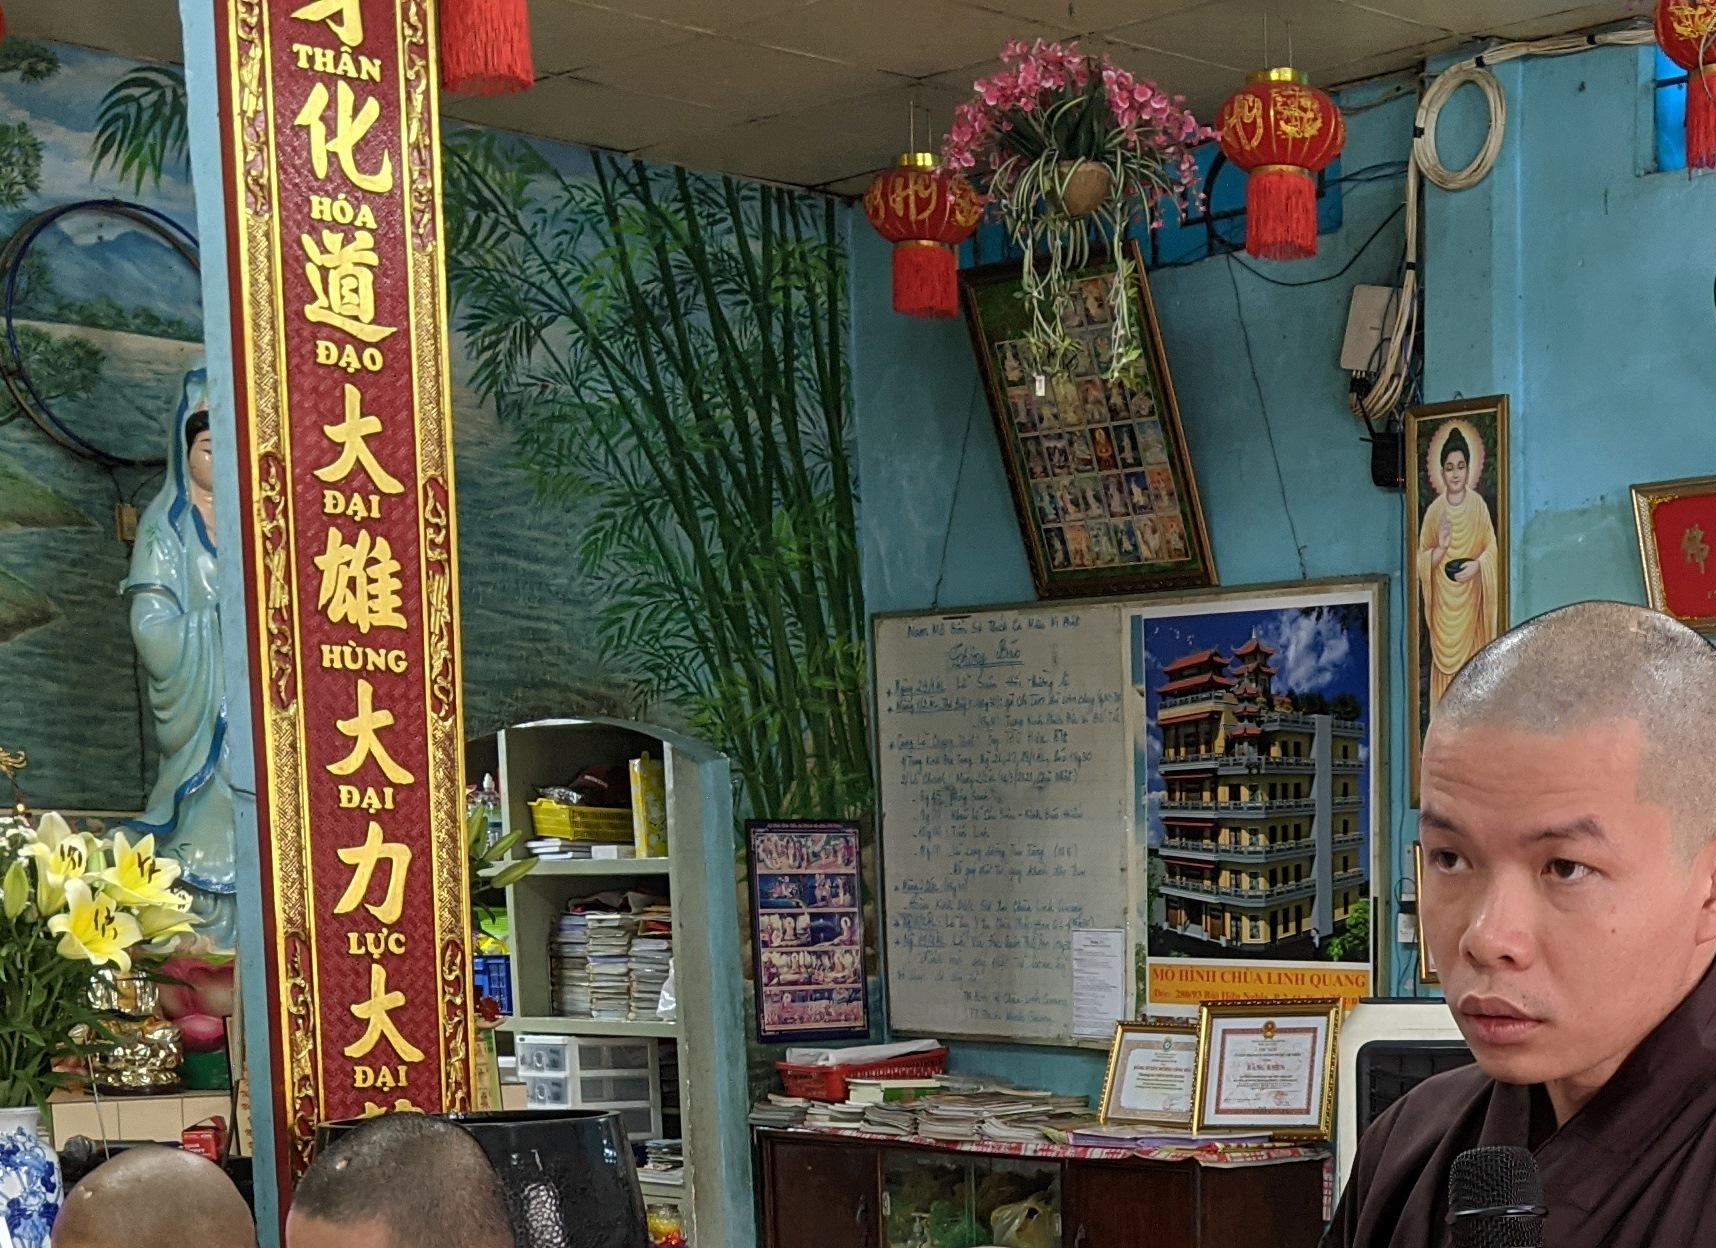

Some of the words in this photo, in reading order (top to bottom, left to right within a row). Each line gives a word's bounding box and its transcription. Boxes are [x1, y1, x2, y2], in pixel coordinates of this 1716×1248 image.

[292, 43, 382, 82] THÂN
[294, 81, 392, 193] 化
[301, 230, 397, 343] 道
[315, 341, 383, 374] ĐẠO
[313, 383, 404, 495] 大
[323, 491, 382, 523] ĐẠI
[313, 527, 408, 634] 雄
[321, 641, 408, 674] HÙNG
[326, 679, 415, 784] 大
[339, 784, 395, 814] ĐẠI
[334, 821, 413, 925] 力
[347, 929, 406, 957] LỰC
[1153, 966, 1175, 983] MÔ
[1180, 965, 1216, 983] HÌNH
[1221, 967, 1263, 985] CHÙA
[1310, 973, 1365, 989] QUANG
[344, 963, 425, 1062] 大
[353, 1066, 409, 1090] ĐẠI
